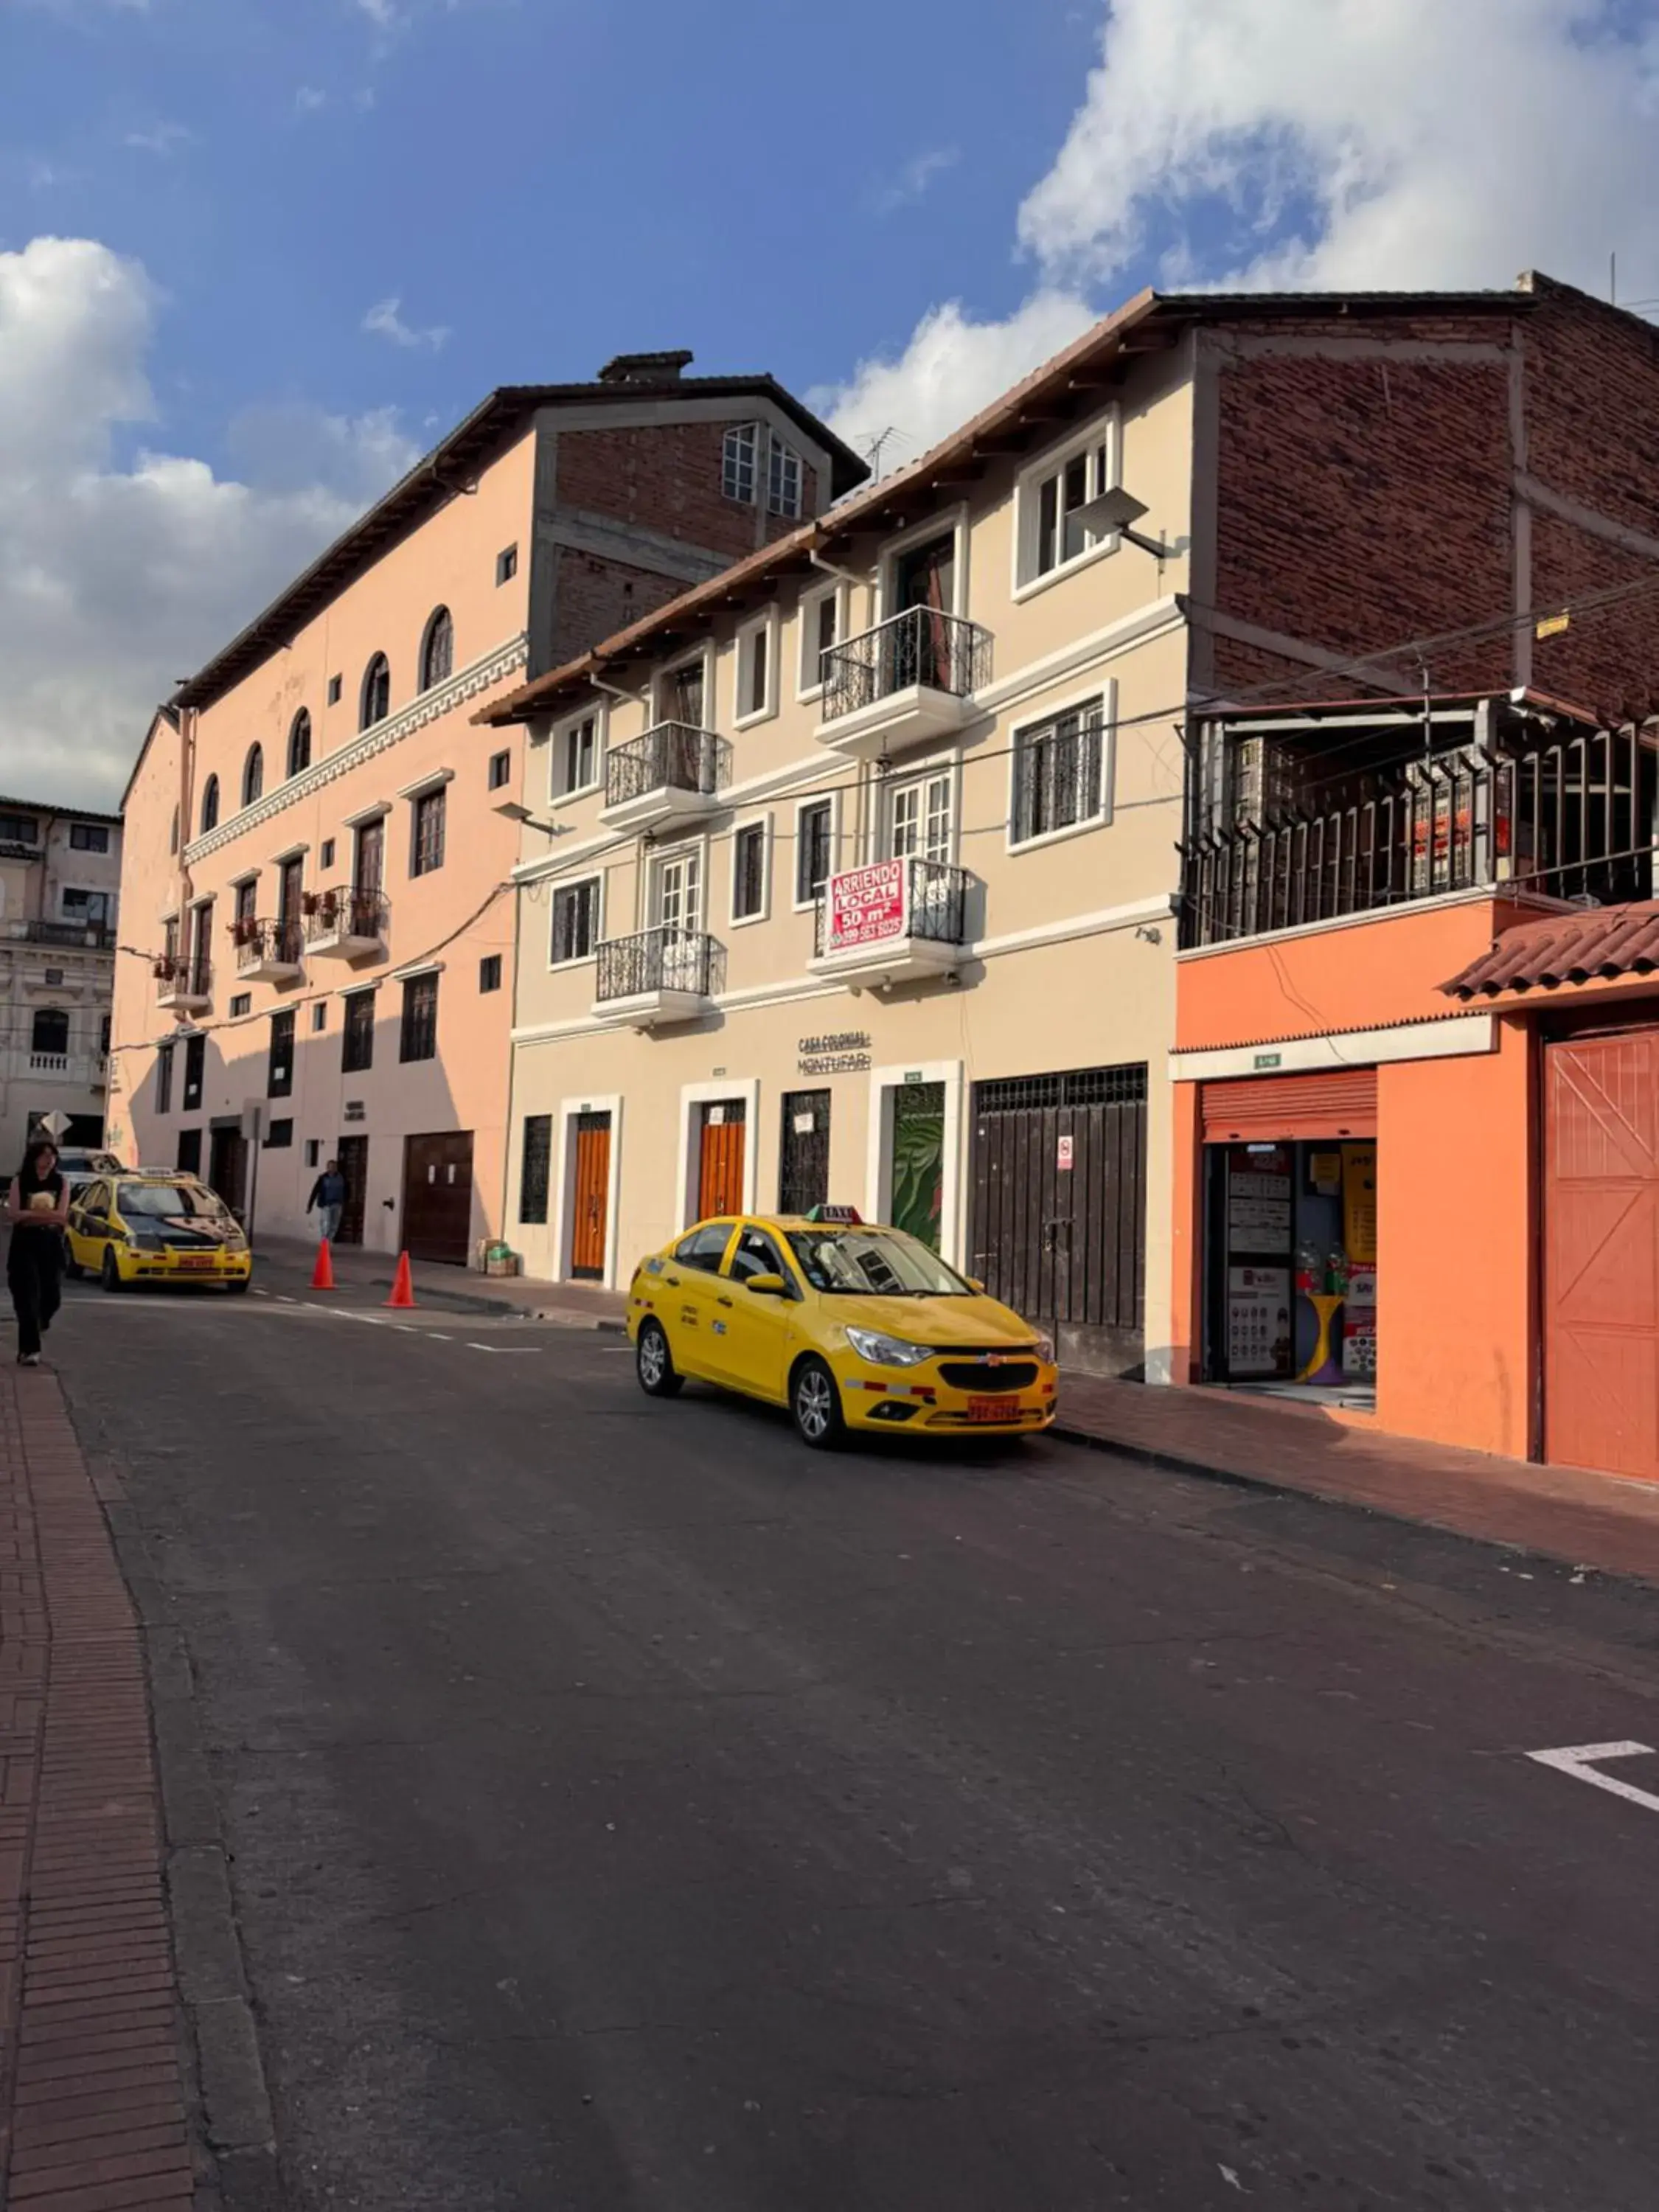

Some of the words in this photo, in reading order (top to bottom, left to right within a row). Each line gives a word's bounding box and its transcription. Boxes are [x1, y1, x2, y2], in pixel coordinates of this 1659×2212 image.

[835, 862, 900, 896] ARRIENDO
[838, 886, 894, 910] LOCAL
[842, 911, 861, 929] 50
[825, 1206, 852, 1218] TAXI
